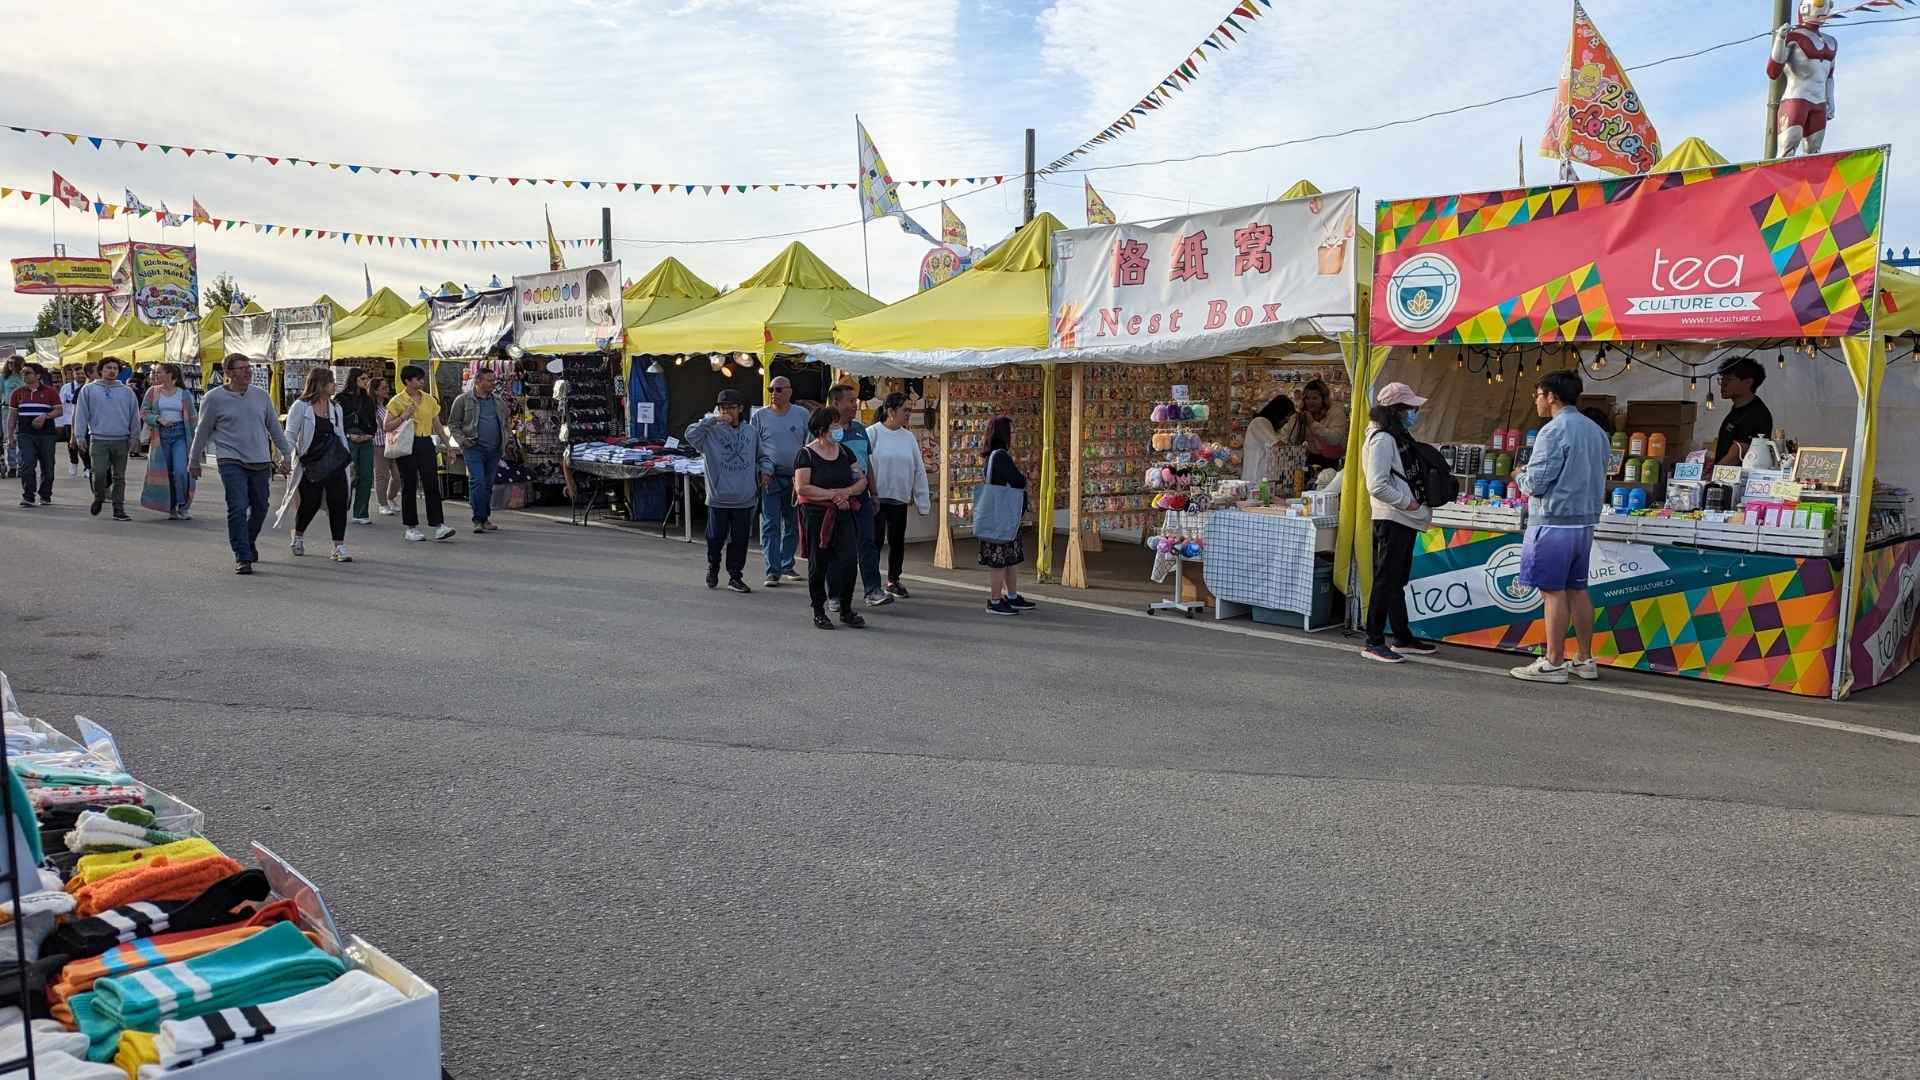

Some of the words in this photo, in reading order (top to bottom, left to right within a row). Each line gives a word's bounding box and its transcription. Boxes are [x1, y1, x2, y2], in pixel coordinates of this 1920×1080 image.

[1650, 247, 1745, 291] tea
[1096, 307, 1184, 337] Nest
[1203, 299, 1282, 330] Box
[1639, 296, 1714, 312] CULTURE
[1719, 295, 1748, 309] CO.
[1410, 581, 1473, 616] tea
[1603, 579, 1676, 598] WWW.TEACULTURE.CA
